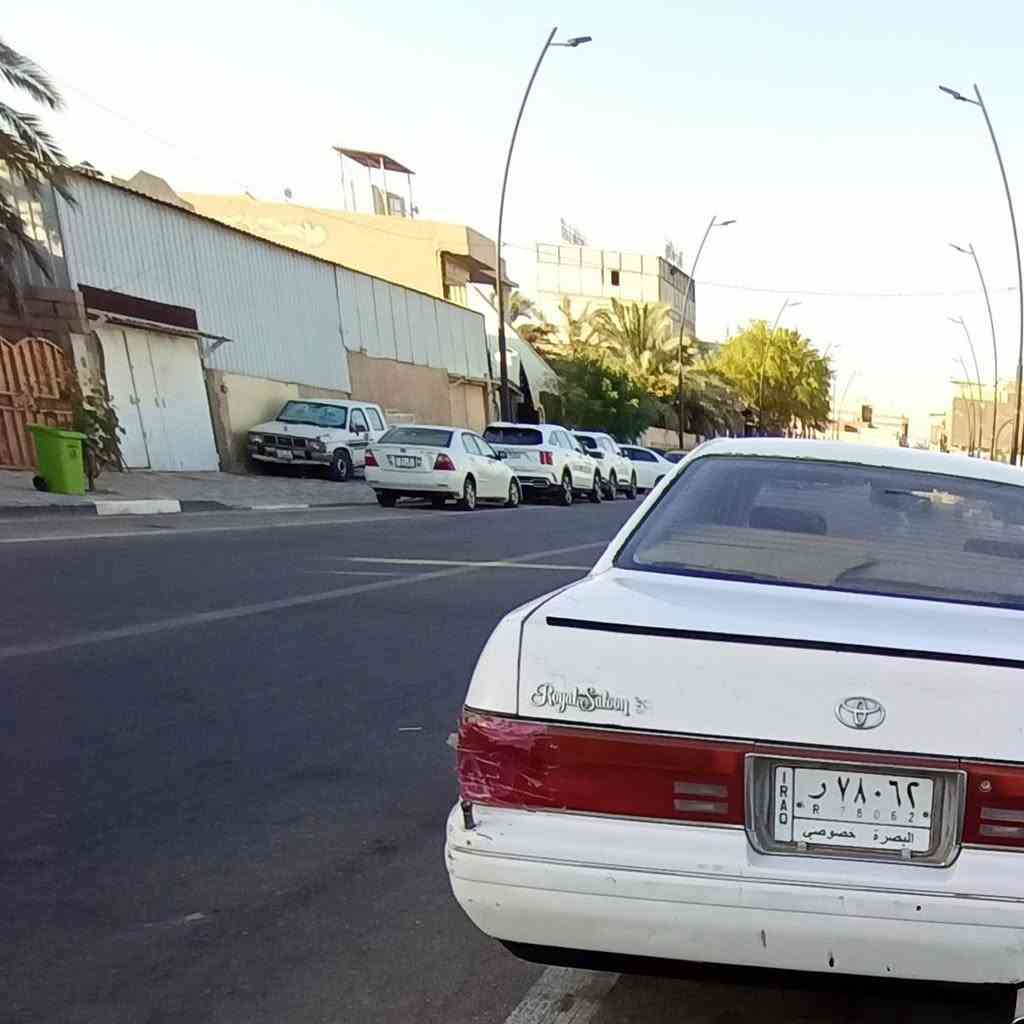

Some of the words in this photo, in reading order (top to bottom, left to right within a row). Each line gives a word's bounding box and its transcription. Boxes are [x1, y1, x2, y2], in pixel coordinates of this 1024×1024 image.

[531, 683, 579, 713] Royal
[577, 687, 630, 716] Saloon
[779, 771, 788, 824] IRAQ
[802, 826, 856, 843] خصوصي
[873, 831, 914, 847] البصرة
